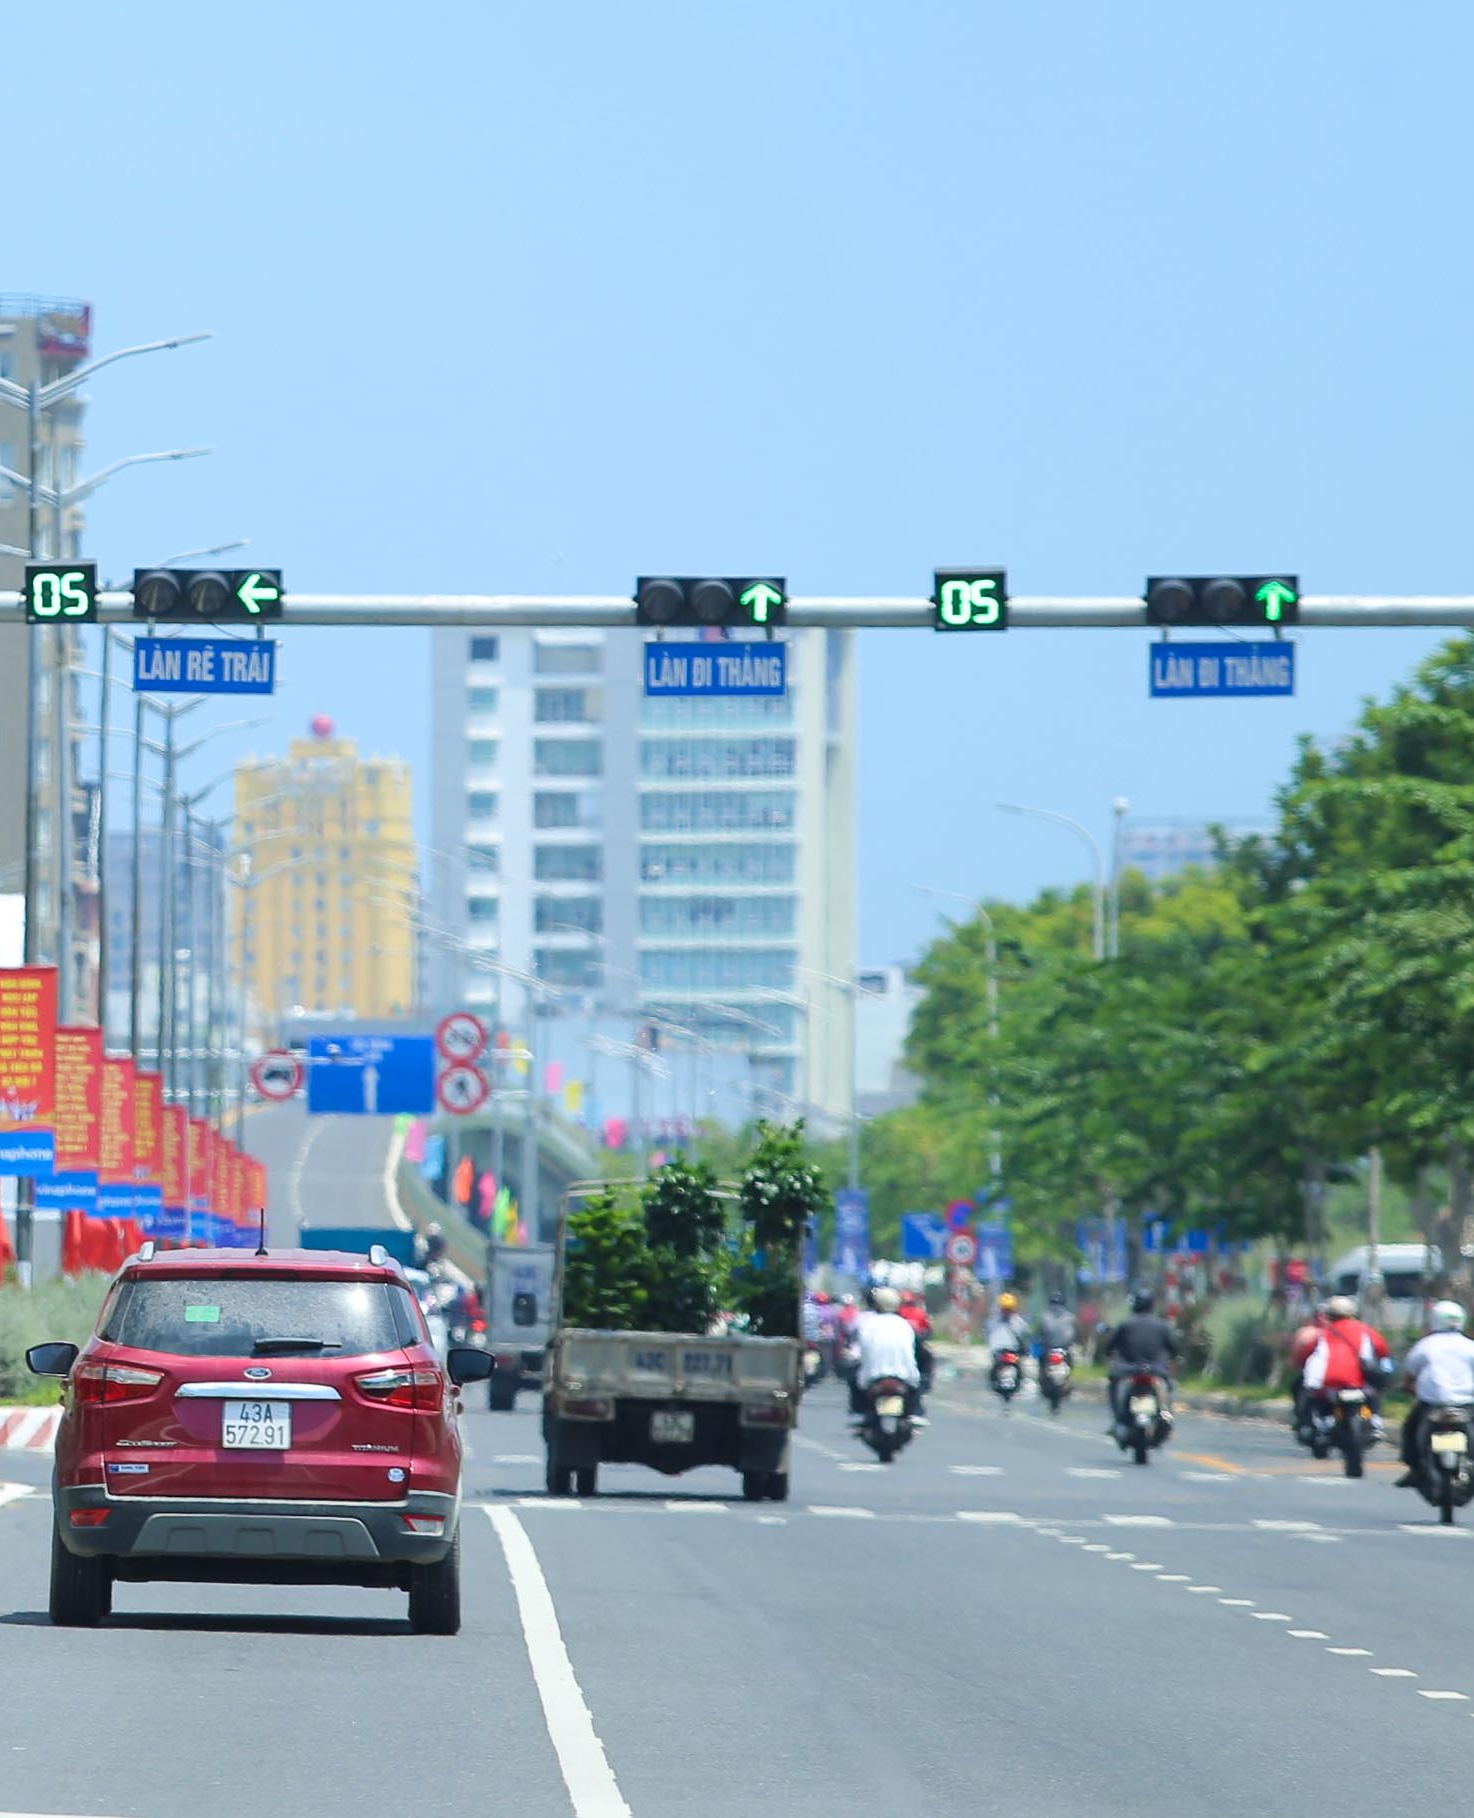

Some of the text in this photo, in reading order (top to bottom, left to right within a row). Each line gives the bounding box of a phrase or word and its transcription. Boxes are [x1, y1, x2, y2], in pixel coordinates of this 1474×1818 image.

[33, 572, 89, 617] 05
[941, 579, 999, 624] 05
[138, 644, 271, 683] LÀN RẼ TRÁI
[649, 651, 688, 687] LÀN
[692, 657, 712, 687] ĐI
[1154, 651, 1194, 689] LÀN
[240, 1403, 273, 1423] 43A
[226, 1425, 284, 1446] 572.91
